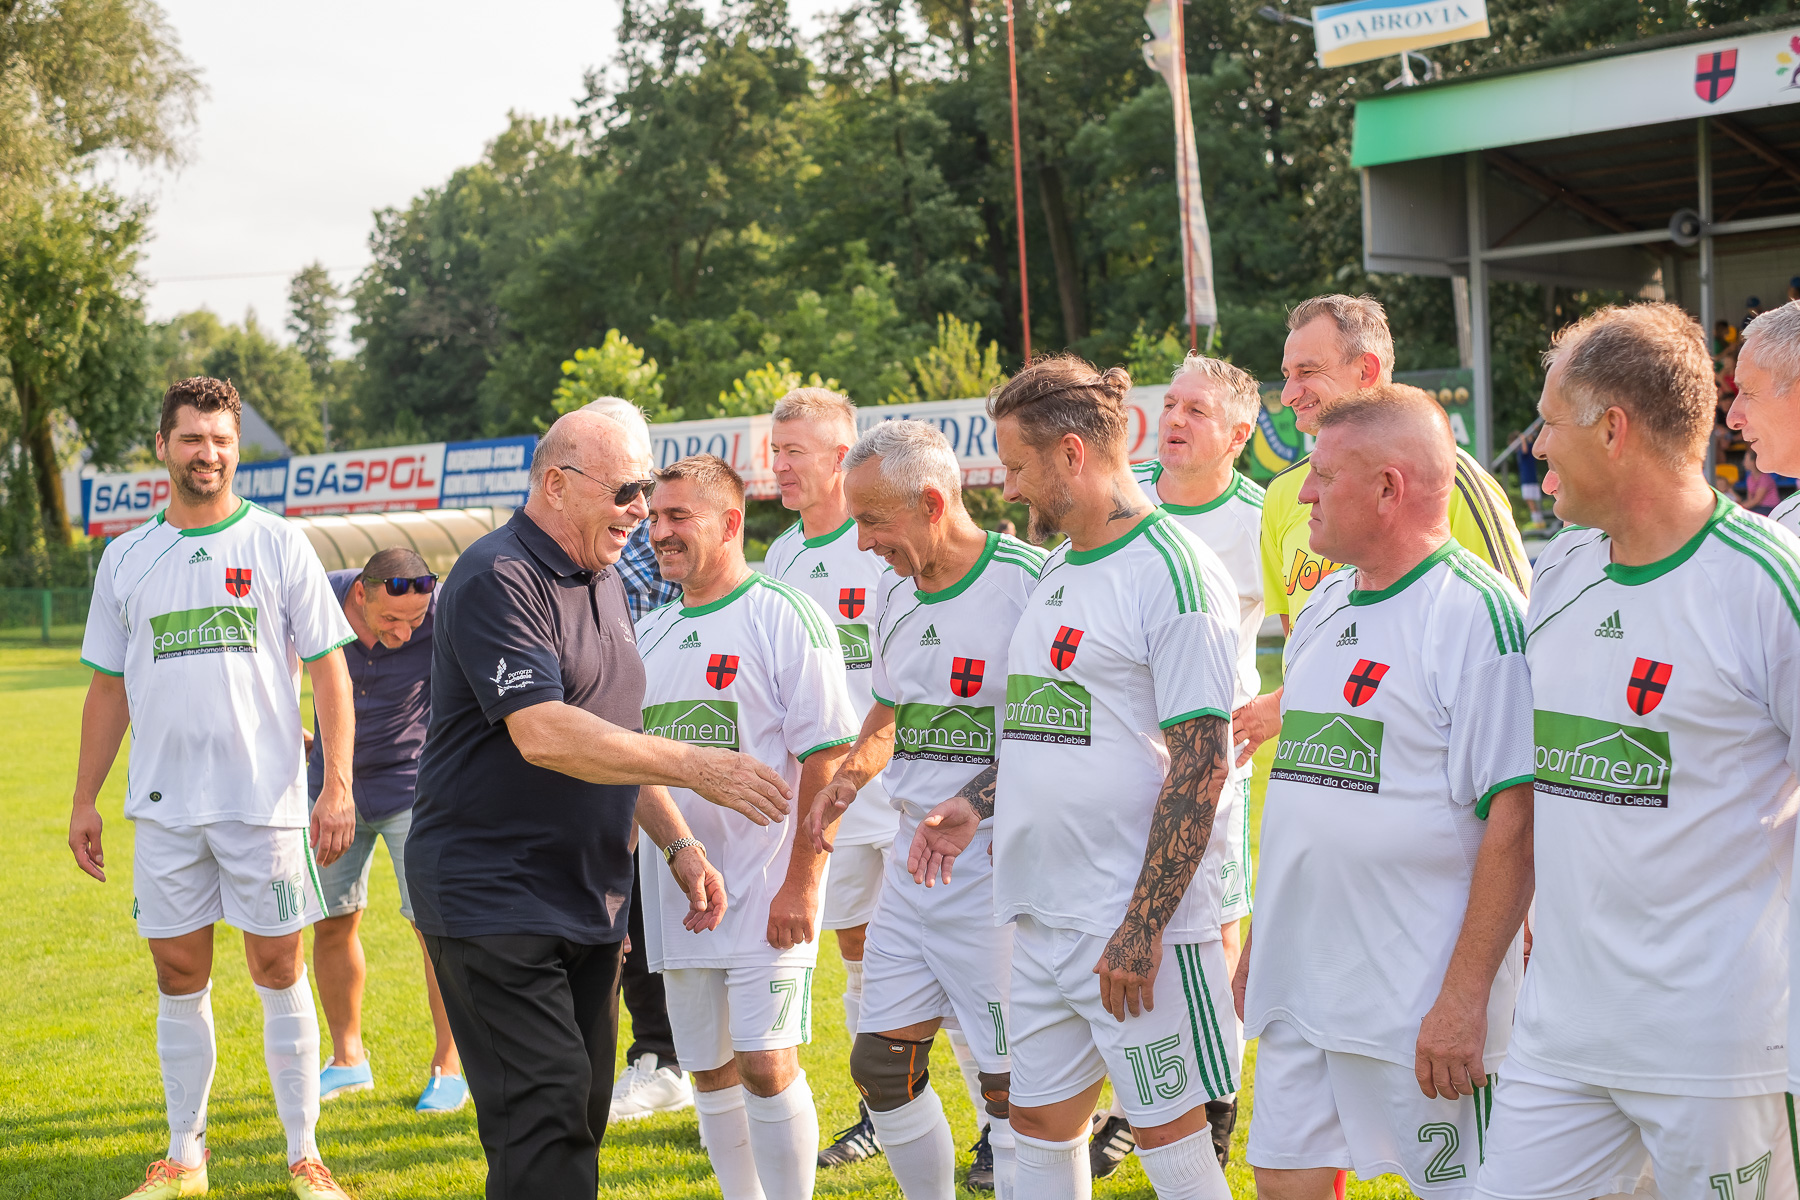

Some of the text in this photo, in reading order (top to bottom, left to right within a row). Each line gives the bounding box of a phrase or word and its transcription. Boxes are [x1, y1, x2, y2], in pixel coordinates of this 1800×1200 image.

[1333, 4, 1469, 40] DĄBROVIA
[294, 455, 435, 496] SASPOL
[95, 480, 170, 512] SASP
[189, 555, 212, 564] adidas
[1045, 598, 1063, 606] adidas
[920, 637, 940, 646] adidas
[1336, 637, 1358, 647] adidas
[1594, 627, 1624, 639] adidas
[679, 640, 701, 650] adidas
[1004, 701, 1089, 728] artment
[645, 721, 737, 743] artment
[1043, 734, 1055, 742] dla
[1057, 735, 1086, 745] Ciebie
[951, 755, 963, 763] dla
[966, 755, 990, 764] Ciebie
[1534, 745, 1669, 788] partment
[1323, 776, 1338, 787] dla
[1341, 779, 1373, 792] Ciebie
[1549, 784, 1603, 801] nieruchomości
[1604, 793, 1622, 804] dla
[1624, 795, 1663, 806] Ciebie
[1220, 861, 1241, 908] 2
[272, 873, 306, 921] 16
[770, 978, 797, 1031] 7
[1124, 1033, 1187, 1105] 15
[1418, 1122, 1467, 1183] 2
